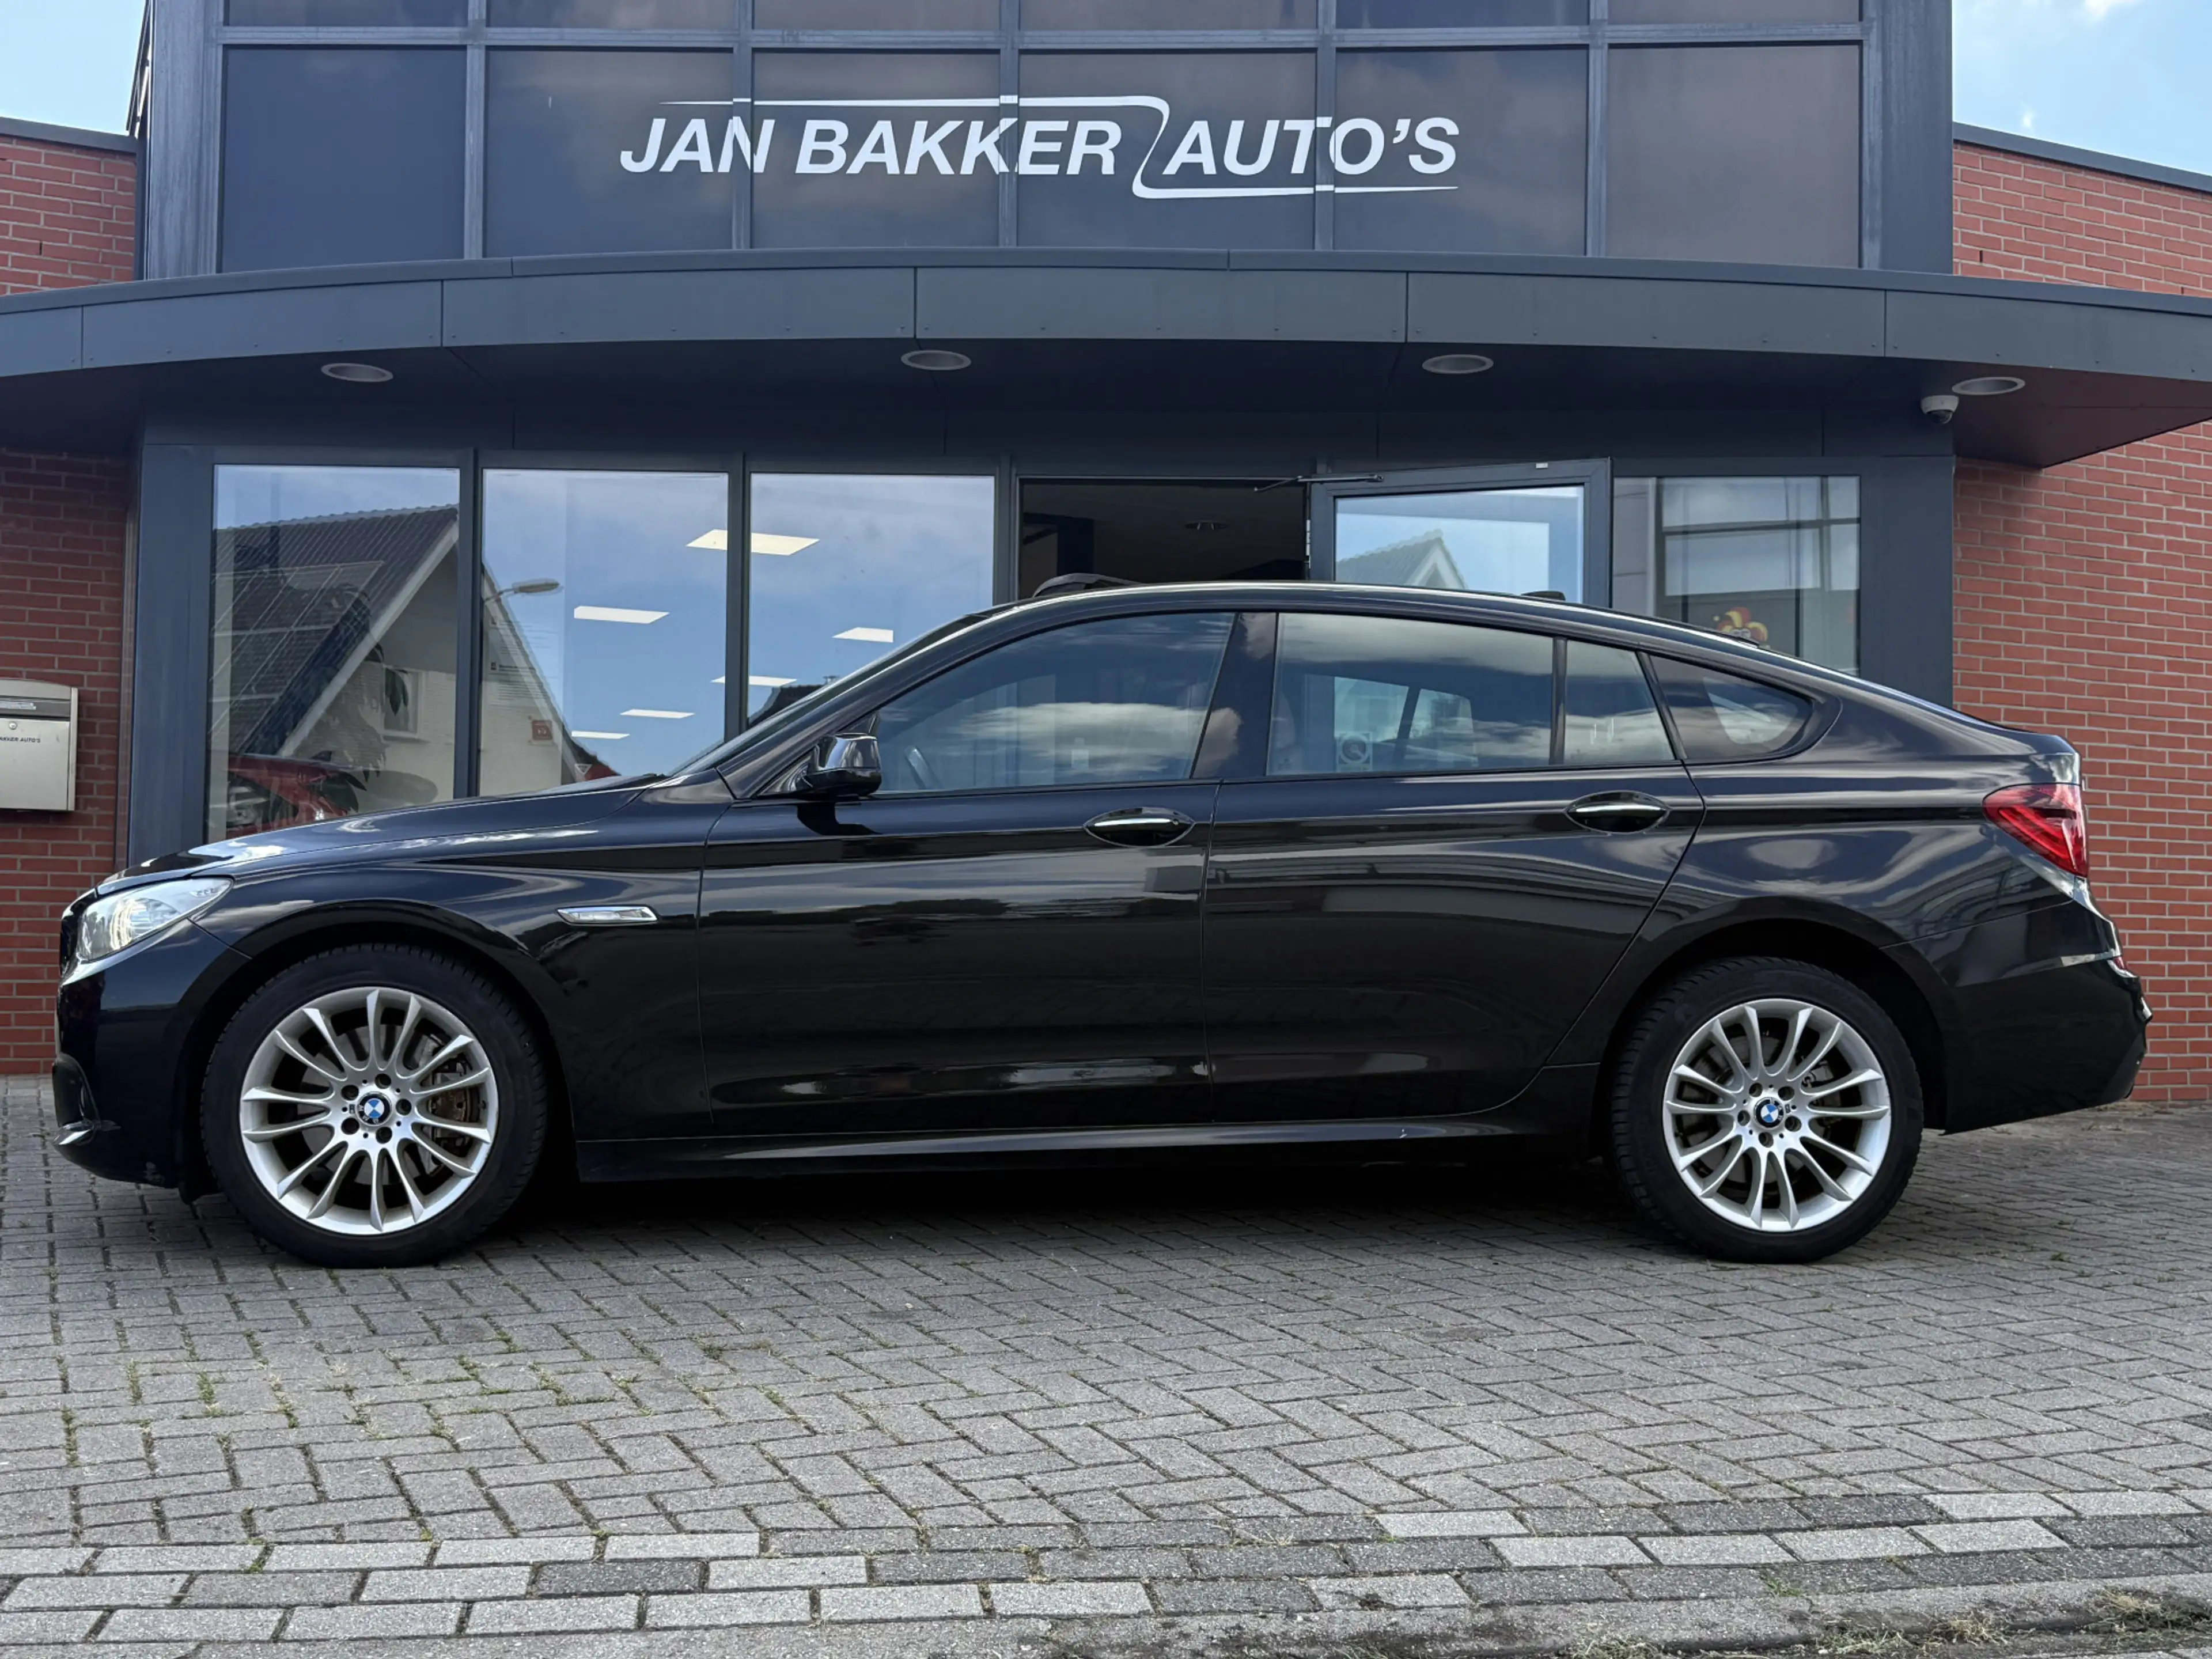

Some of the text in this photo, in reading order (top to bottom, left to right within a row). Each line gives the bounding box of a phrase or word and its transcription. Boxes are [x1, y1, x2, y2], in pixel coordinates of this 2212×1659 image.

[620, 117, 1459, 175] JAN BAKKER AUTO'S
